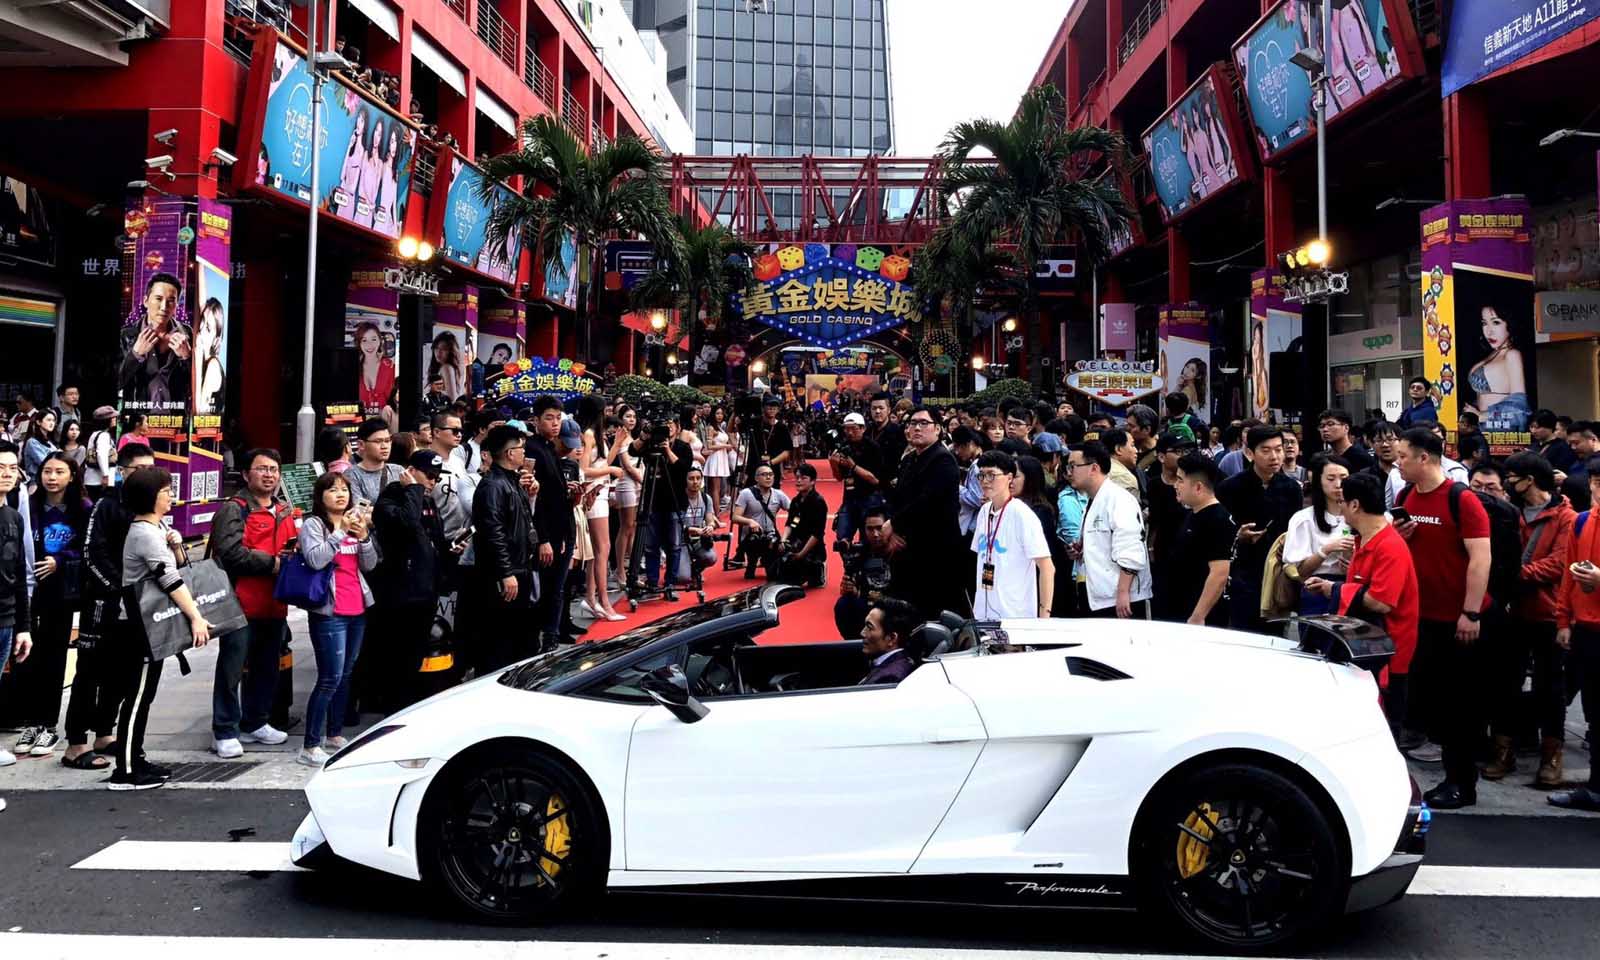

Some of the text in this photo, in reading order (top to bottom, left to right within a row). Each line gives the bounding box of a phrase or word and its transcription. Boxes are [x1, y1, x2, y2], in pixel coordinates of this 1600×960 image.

[82, 258, 120, 277] 世界
[738, 277, 923, 323] 黃金娛樂城
[789, 315, 873, 326] GOLD CASINO
[1076, 361, 1152, 373] WELCOME
[497, 374, 595, 397] 黃金娛樂城
[1005, 882, 1122, 895] Performante
